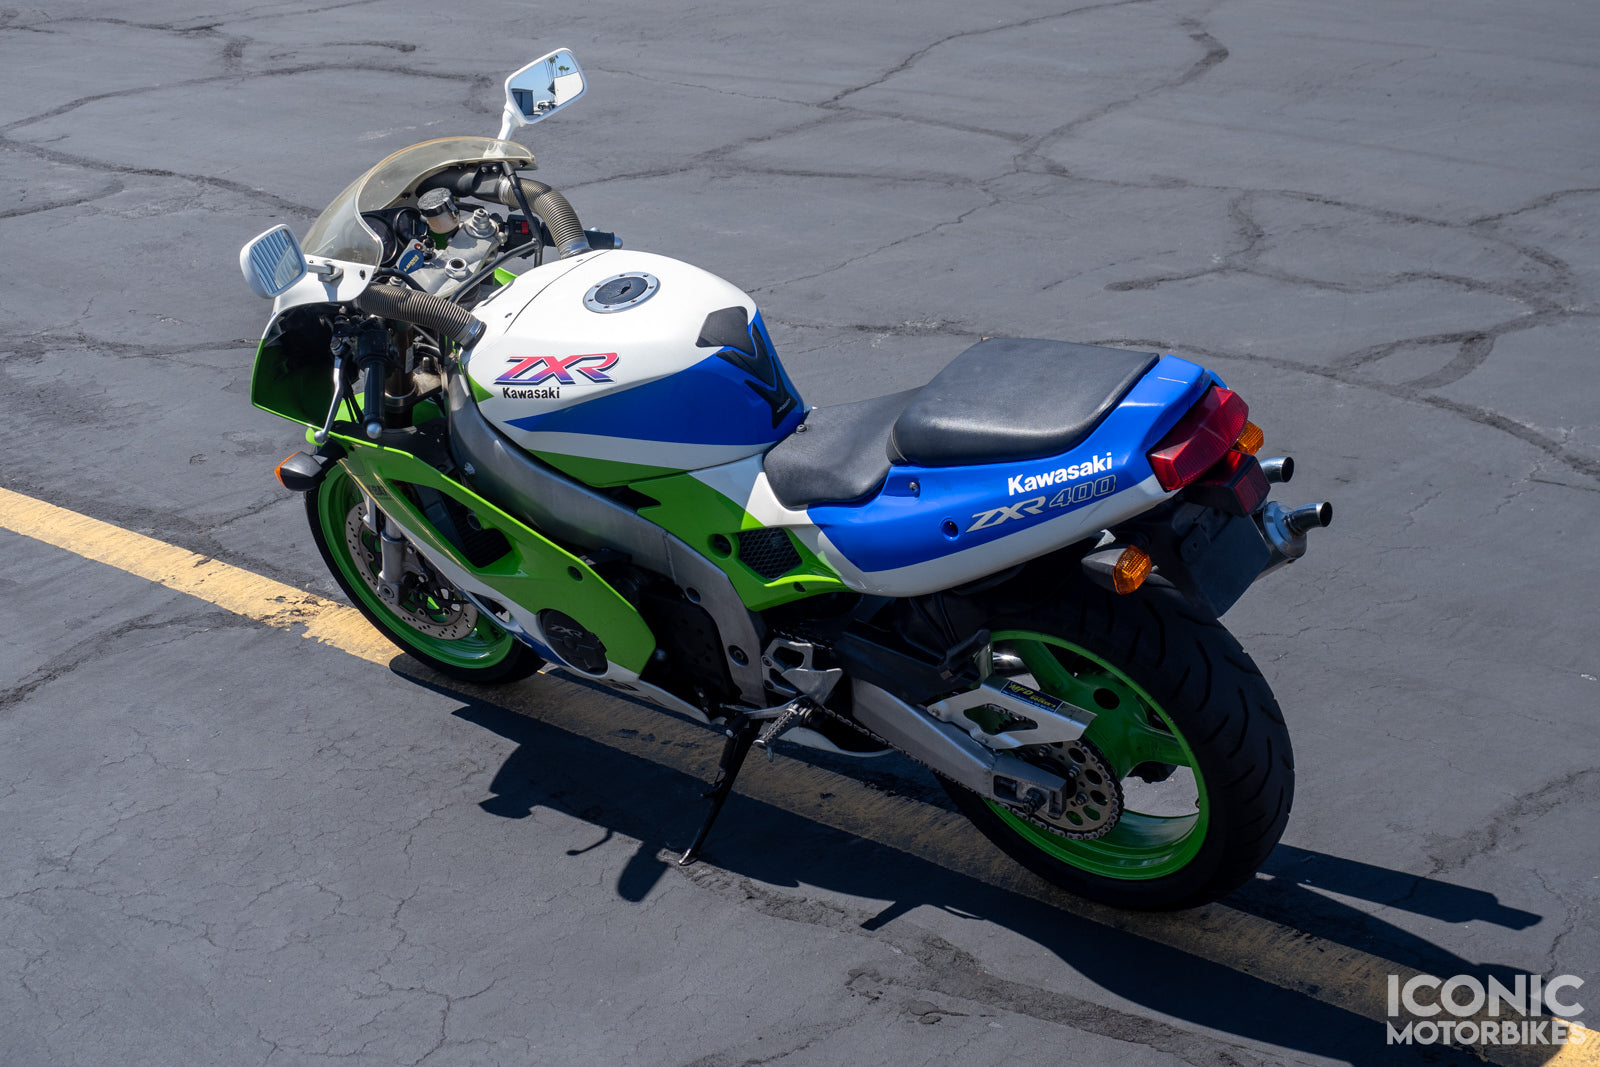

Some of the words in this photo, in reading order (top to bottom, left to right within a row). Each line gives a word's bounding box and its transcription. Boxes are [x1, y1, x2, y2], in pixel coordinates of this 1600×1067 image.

[493, 352, 619, 385] ZXR
[503, 387, 560, 399] Kawasaki
[1008, 452, 1113, 496] Kawasaki
[965, 496, 1046, 533] ZXR
[1049, 474, 1117, 508] 400
[550, 623, 583, 639] ZXR
